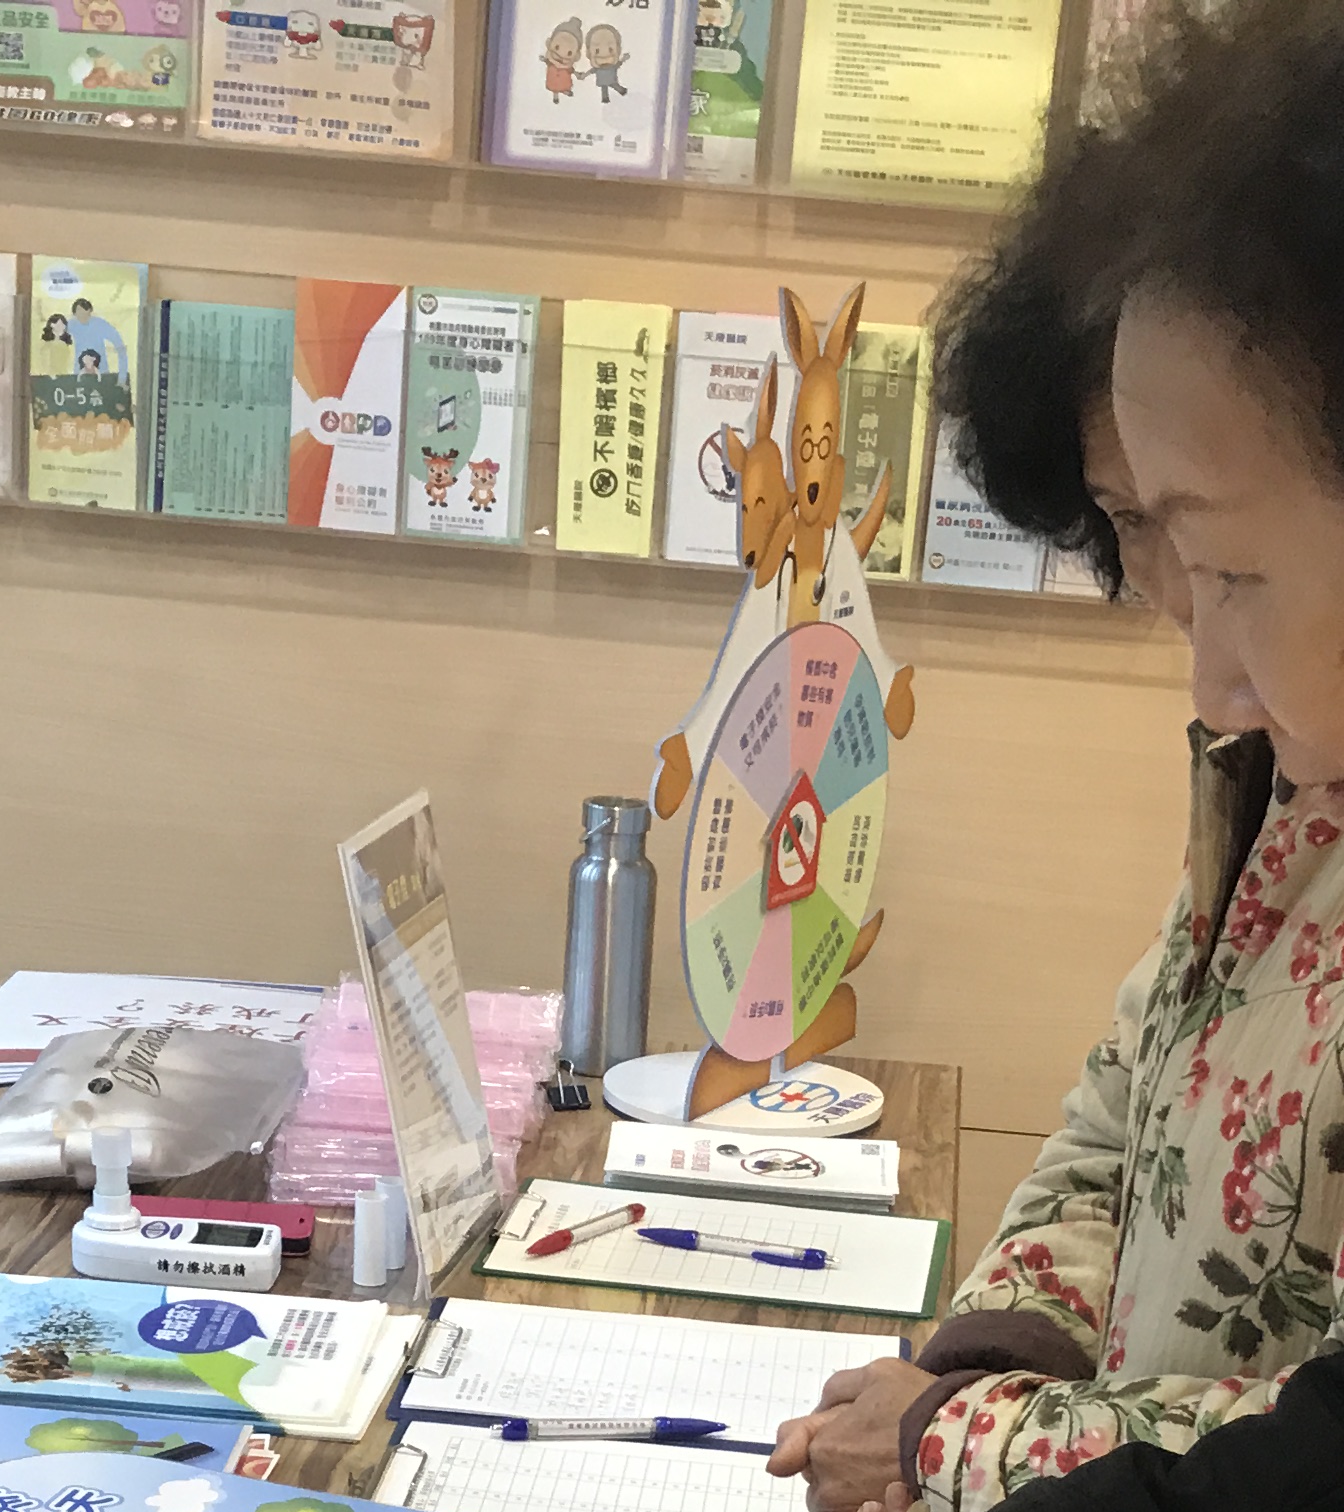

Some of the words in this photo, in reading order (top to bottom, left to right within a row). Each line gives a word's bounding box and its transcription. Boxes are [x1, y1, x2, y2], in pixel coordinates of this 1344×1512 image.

[592, 360, 619, 462] 不嚼檳榔
[157, 1258, 247, 1278] 請勿擦拭酒精
